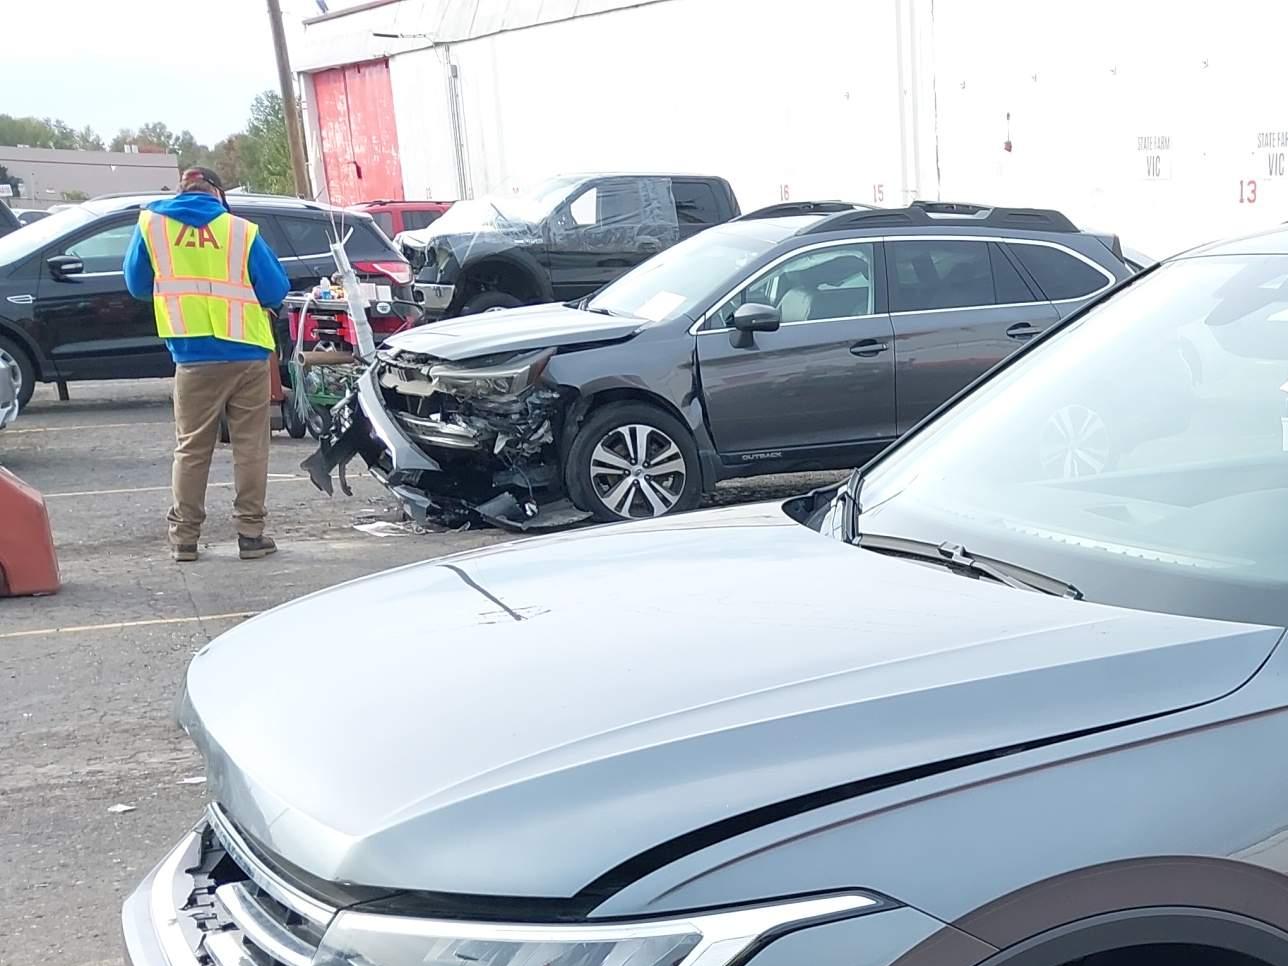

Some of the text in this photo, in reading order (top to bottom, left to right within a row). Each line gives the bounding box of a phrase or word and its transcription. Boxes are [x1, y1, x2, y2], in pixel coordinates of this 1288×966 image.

[1257, 133, 1276, 148] STATE
[1146, 155, 1161, 177] VIC
[1268, 152, 1285, 176] VIC
[780, 184, 790, 201] 16
[873, 184, 884, 202] 15
[1239, 180, 1257, 203] 13
[742, 451, 782, 460] OUTBACK
